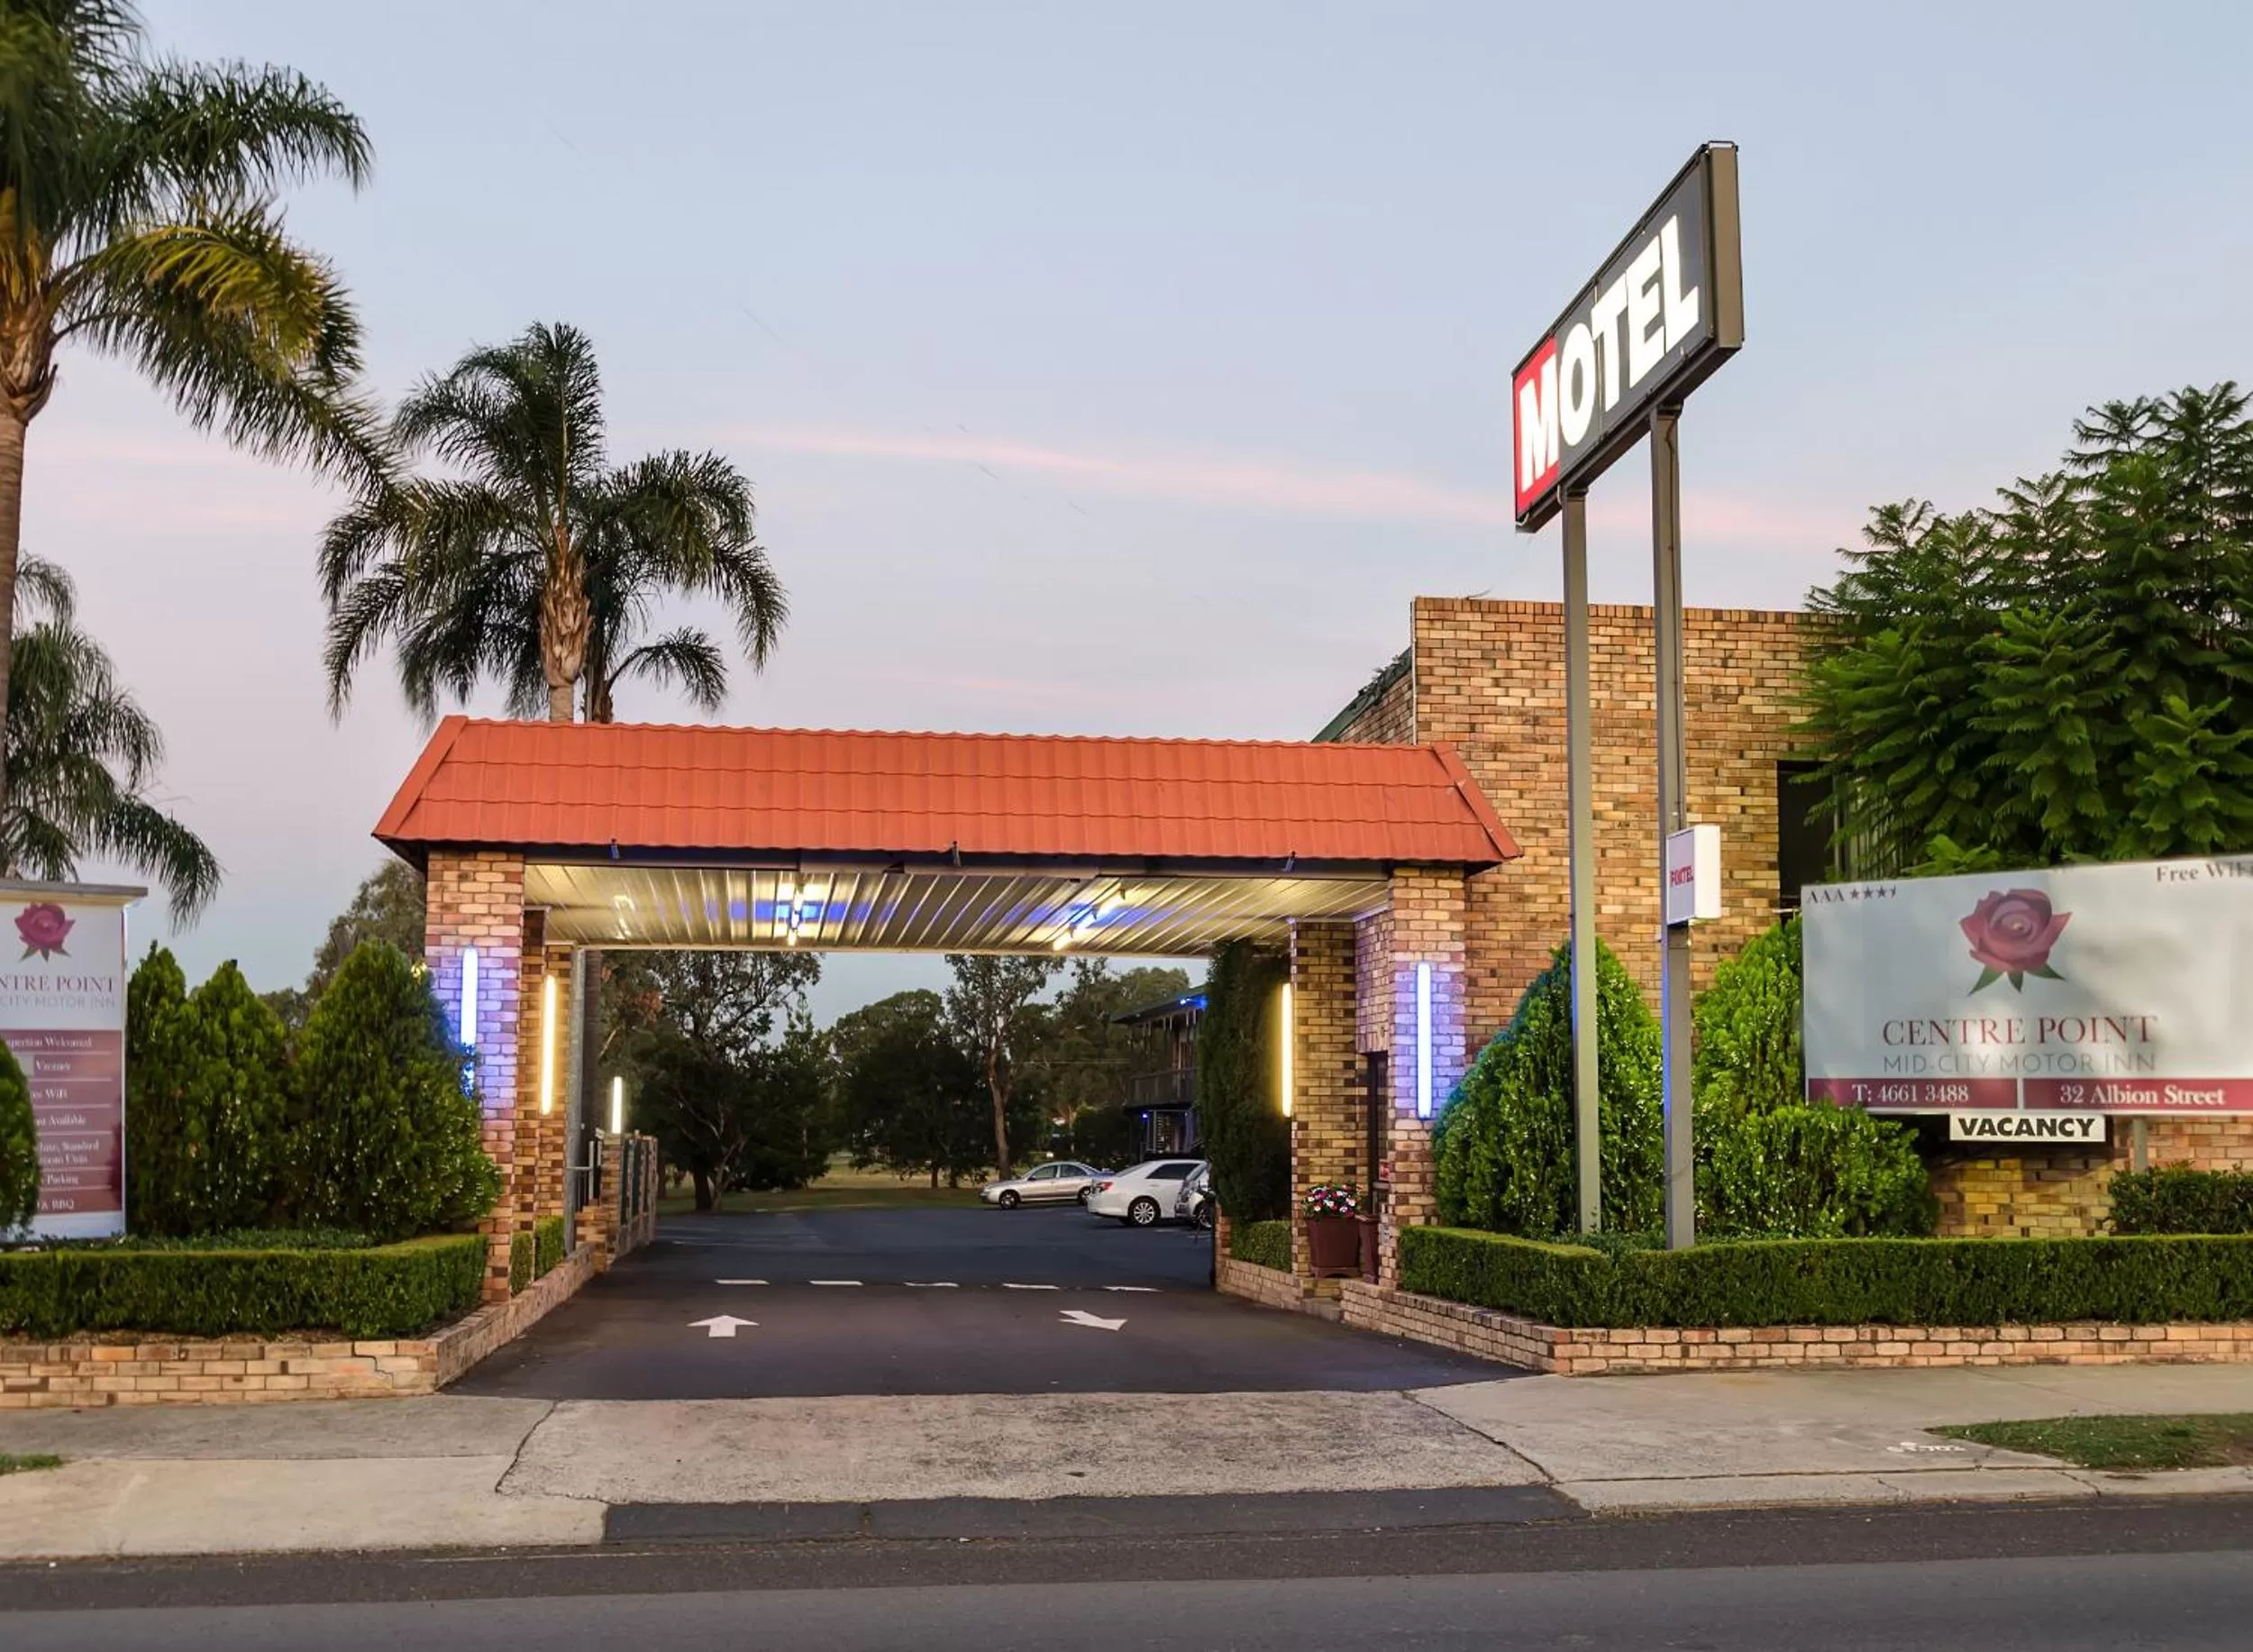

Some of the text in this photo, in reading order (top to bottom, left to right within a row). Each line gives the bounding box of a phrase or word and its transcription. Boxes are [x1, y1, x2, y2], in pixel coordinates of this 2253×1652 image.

[1519, 214, 1699, 493] MOTEL
[2157, 866, 2199, 882] Free
[0, 974, 114, 992] NTRE POINT
[1883, 1016, 2158, 1046] CENTRE POINT
[2000, 1053, 2093, 1073] MOTOR
[2105, 1053, 2156, 1072] INN
[1852, 1084, 1969, 1102] T: 4661 3488
[2060, 1084, 2226, 1105] 32 Albion Street
[1958, 1117, 2096, 1137] VACANCY
